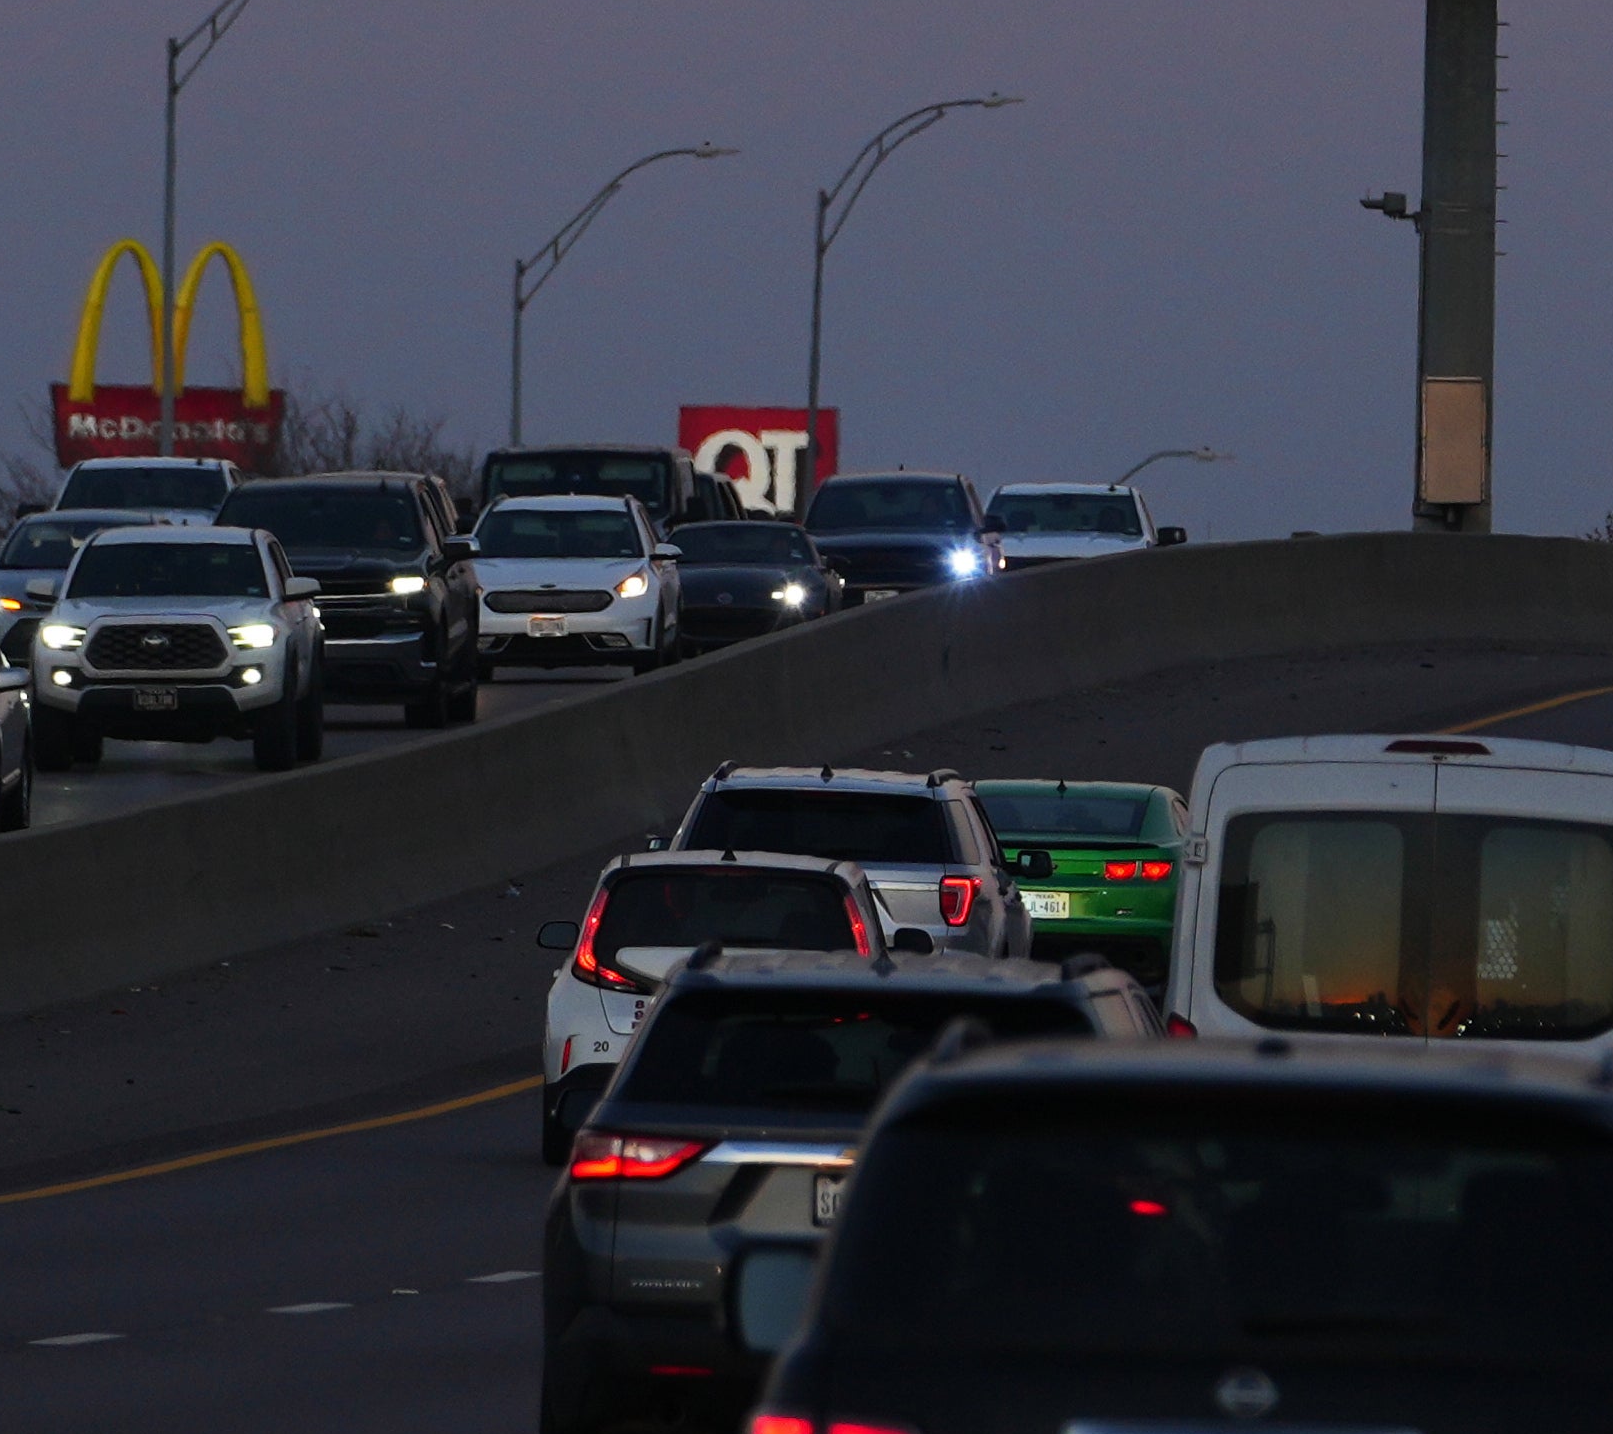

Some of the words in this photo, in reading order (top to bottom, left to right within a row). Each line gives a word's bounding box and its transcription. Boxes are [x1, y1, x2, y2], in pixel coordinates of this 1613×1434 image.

[68, 413, 272, 444] McDonald's
[694, 428, 810, 516] QT
[593, 1041, 609, 1053] 20
